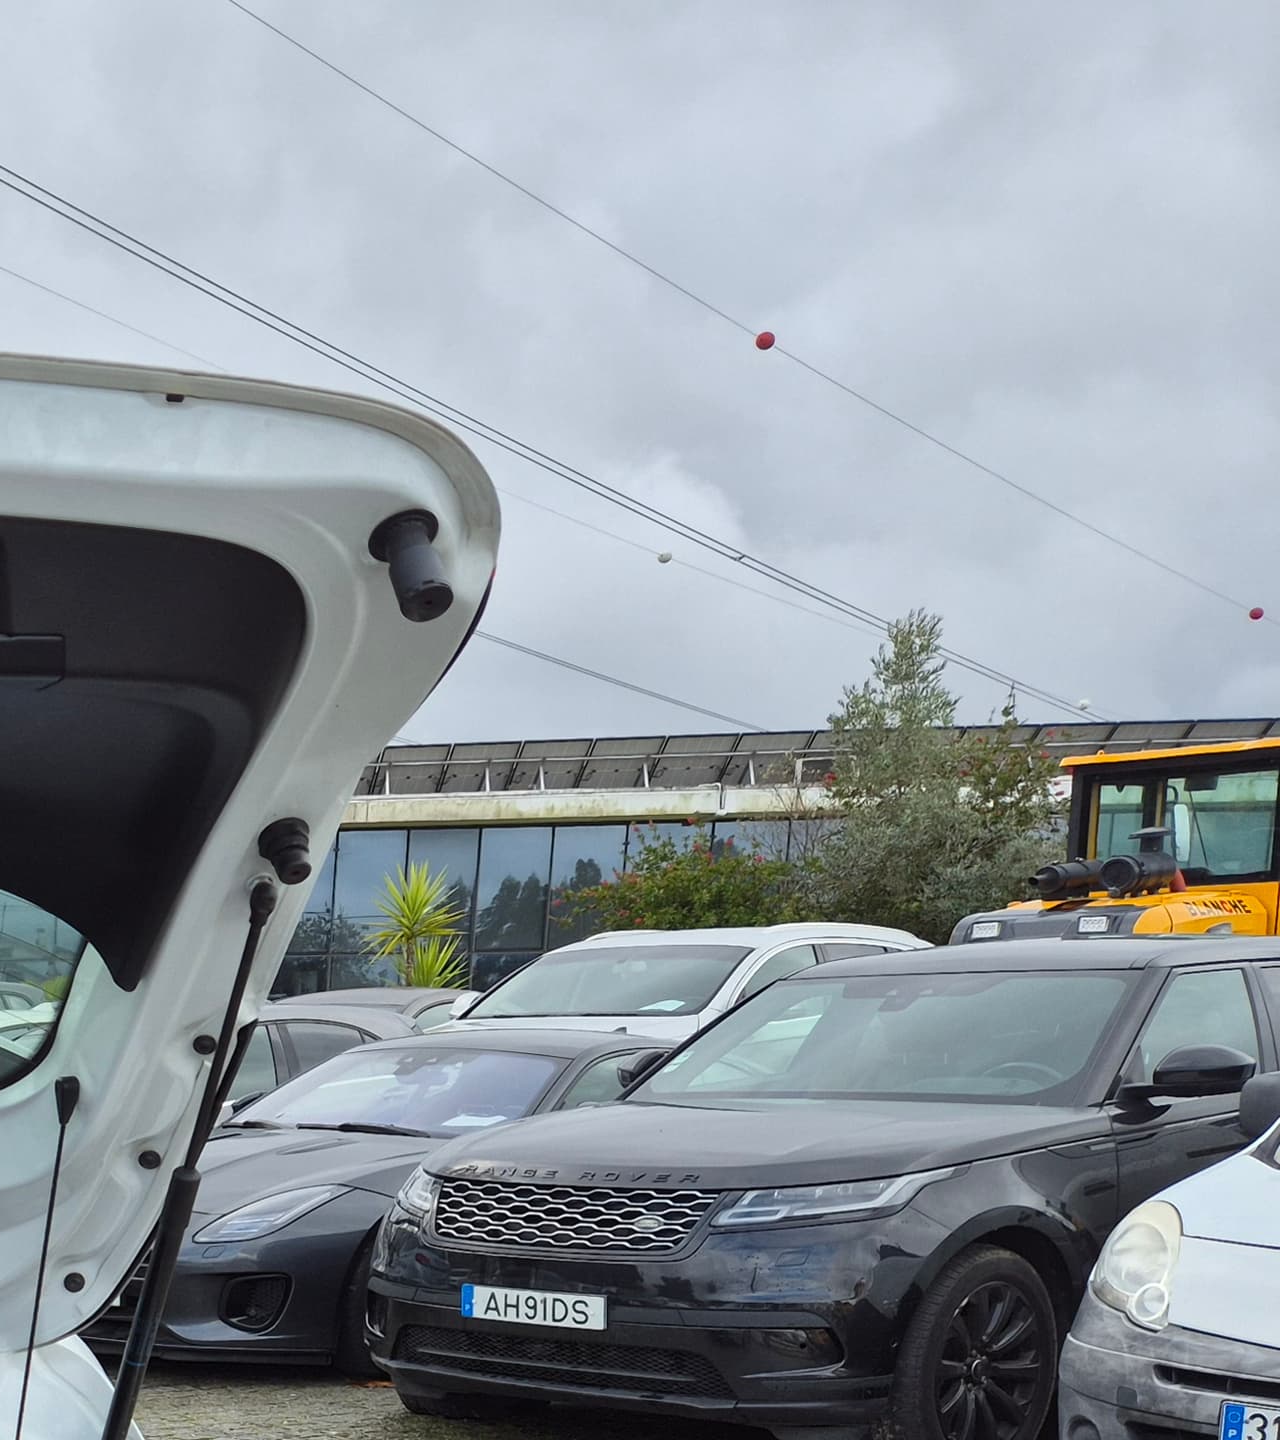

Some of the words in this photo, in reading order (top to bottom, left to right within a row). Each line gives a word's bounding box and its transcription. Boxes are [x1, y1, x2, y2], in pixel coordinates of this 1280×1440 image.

[463, 1164, 560, 1181] RANGE
[578, 1170, 701, 1184] ROVER
[484, 1291, 589, 1325] AH91DS
